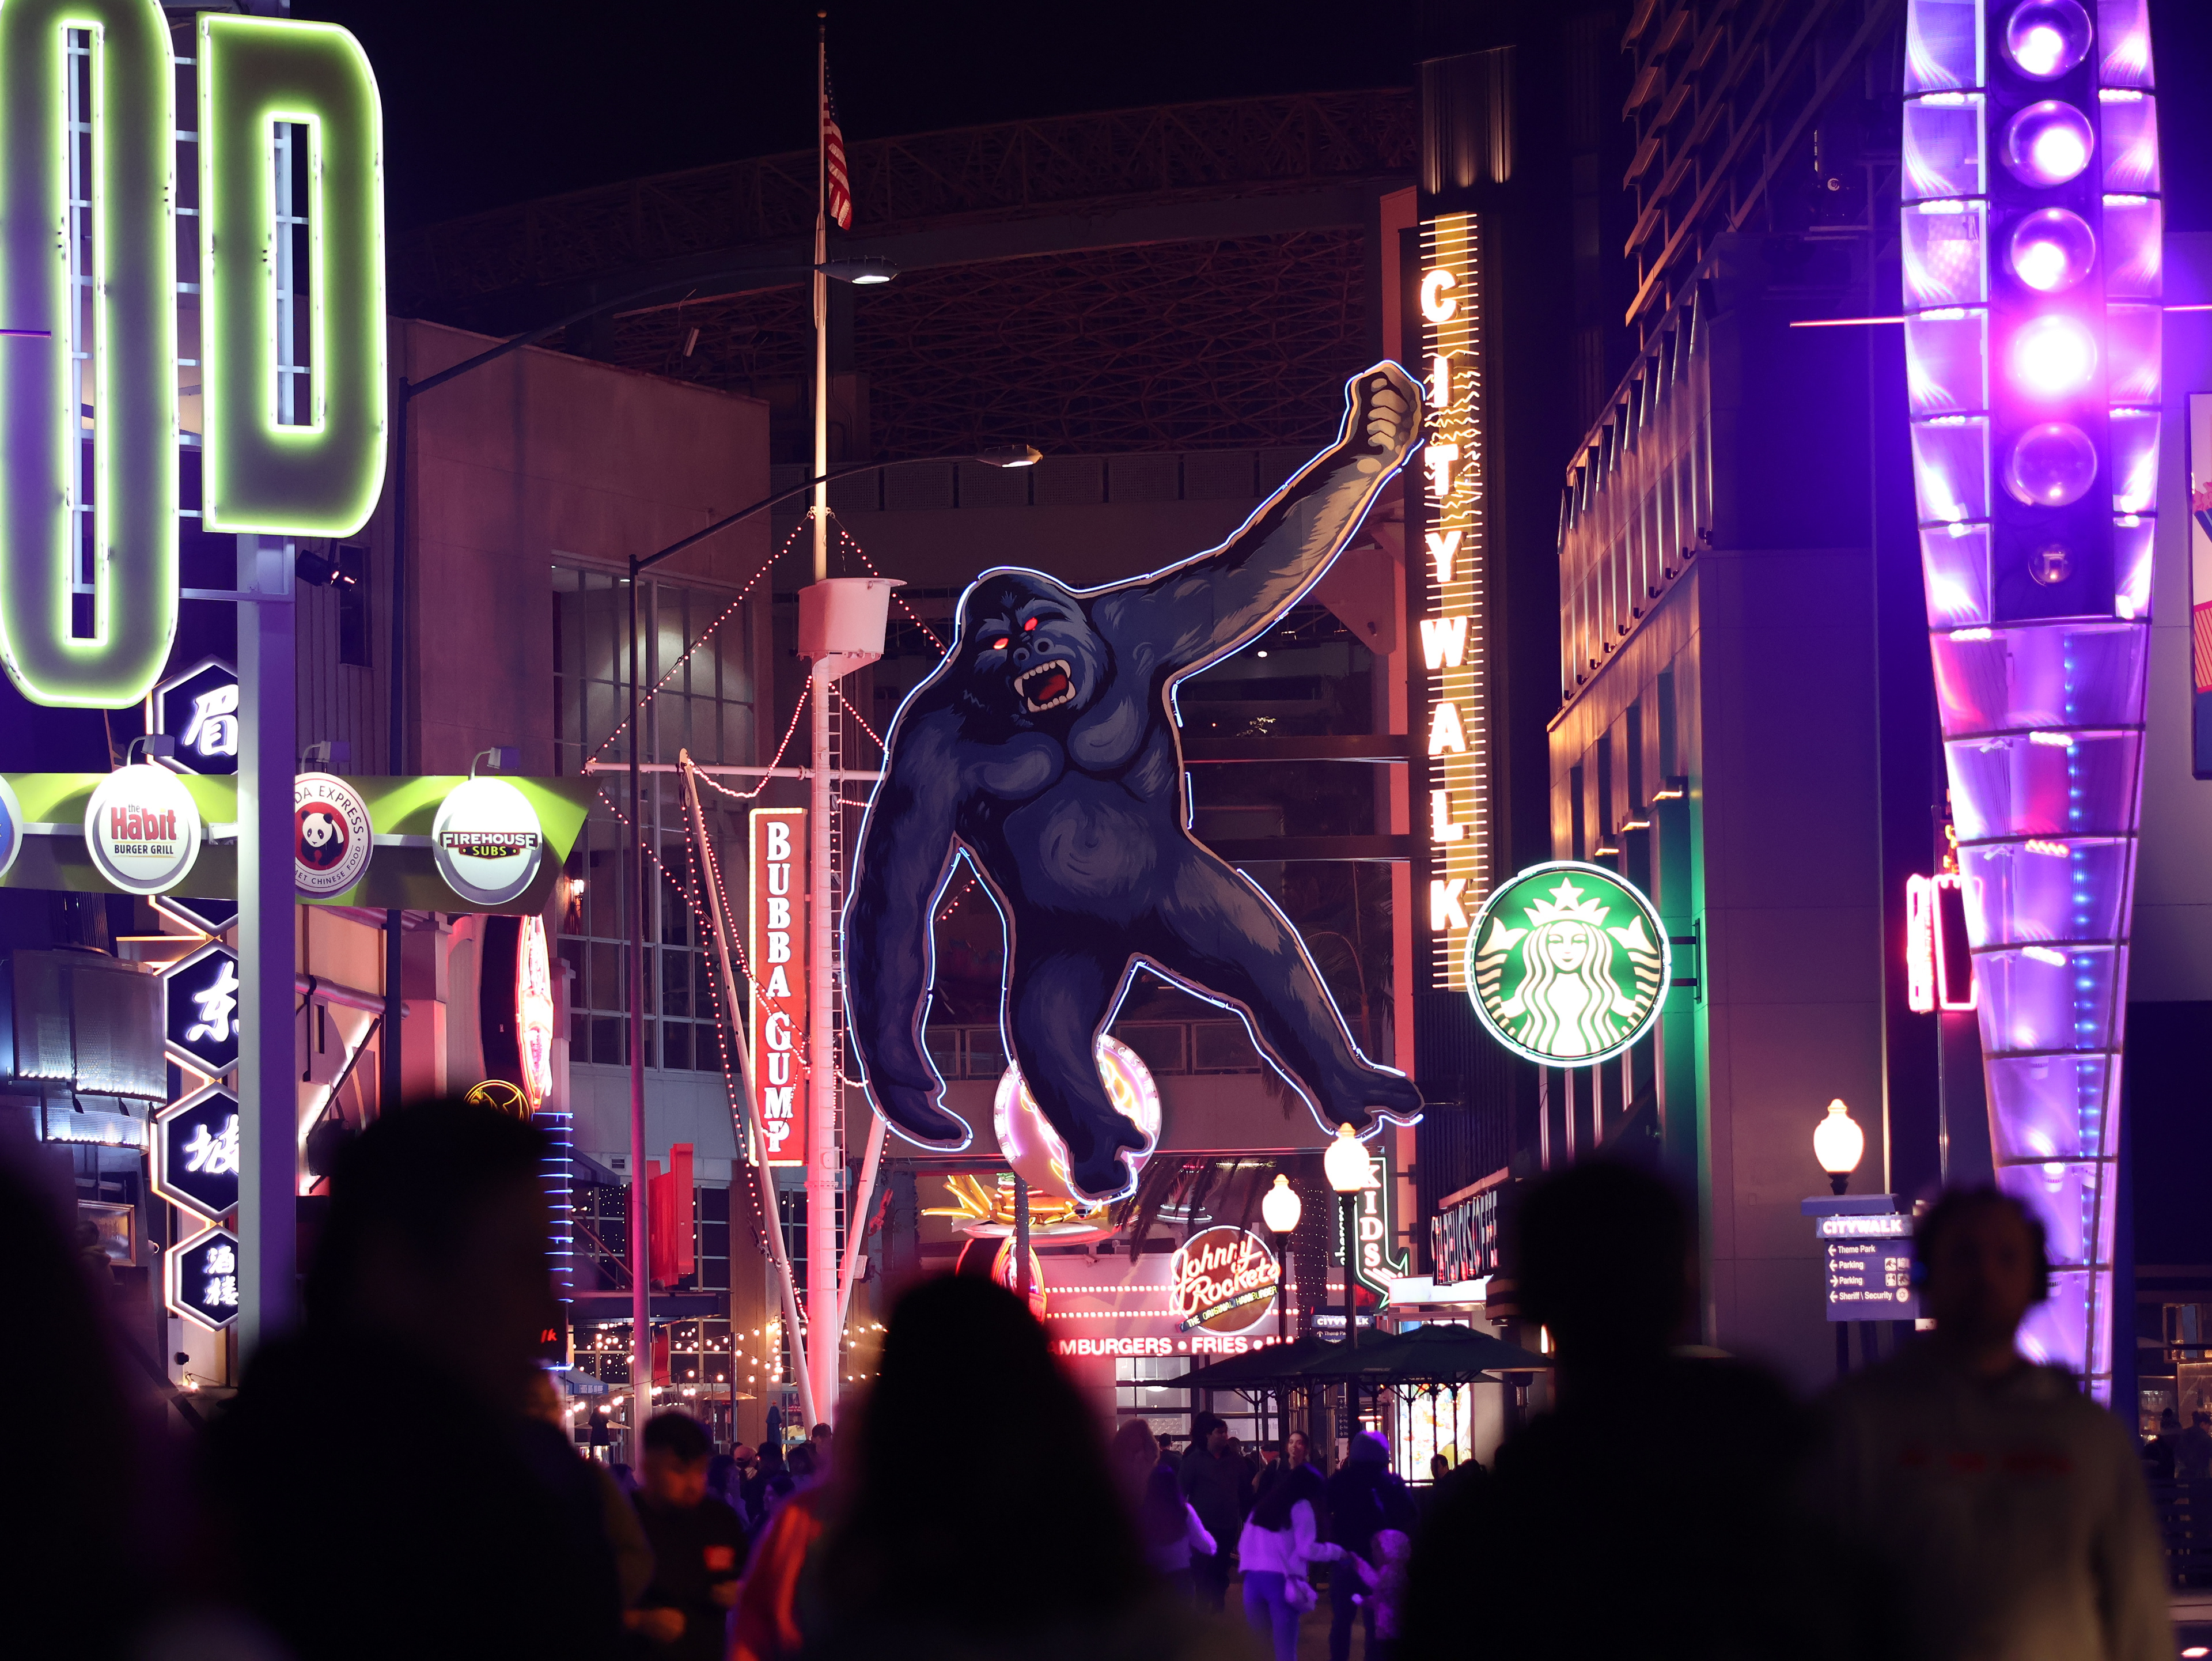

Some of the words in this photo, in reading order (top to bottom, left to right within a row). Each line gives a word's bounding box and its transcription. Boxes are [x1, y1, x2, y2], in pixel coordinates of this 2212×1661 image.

[1419, 270, 1469, 932] CITYWALK
[128, 804, 140, 812] the
[319, 786, 364, 834] EXPRESS
[111, 807, 176, 841] Habit
[115, 845, 148, 854] BURGER
[151, 845, 173, 854] GRILL
[442, 834, 536, 851] FIREHOUSE
[472, 846, 507, 856] SUBS
[312, 872, 345, 884] CHINESE
[347, 846, 361, 870] FOOD
[766, 822, 791, 997] BUBBA
[764, 1012, 793, 1153] GUMP
[1359, 1164, 1384, 1267] KIDS
[1823, 1219, 1902, 1234] CITYWALK
[1838, 1246, 1859, 1254] Theme
[1860, 1244, 1876, 1253] Park
[1170, 1235, 1263, 1313] Johnny
[1839, 1260, 1864, 1270] Parking
[1185, 1257, 1281, 1315] Rockets
[1839, 1276, 1863, 1286] Parking
[1187, 1315, 1201, 1328] THE
[1202, 1300, 1233, 1320] ORIGINAL
[1236, 1285, 1278, 1307] HAMBURGER
[1865, 1291, 1892, 1300] Security
[1053, 1337, 1172, 1355] MBURGERS
[1191, 1337, 1248, 1353] FRIES
